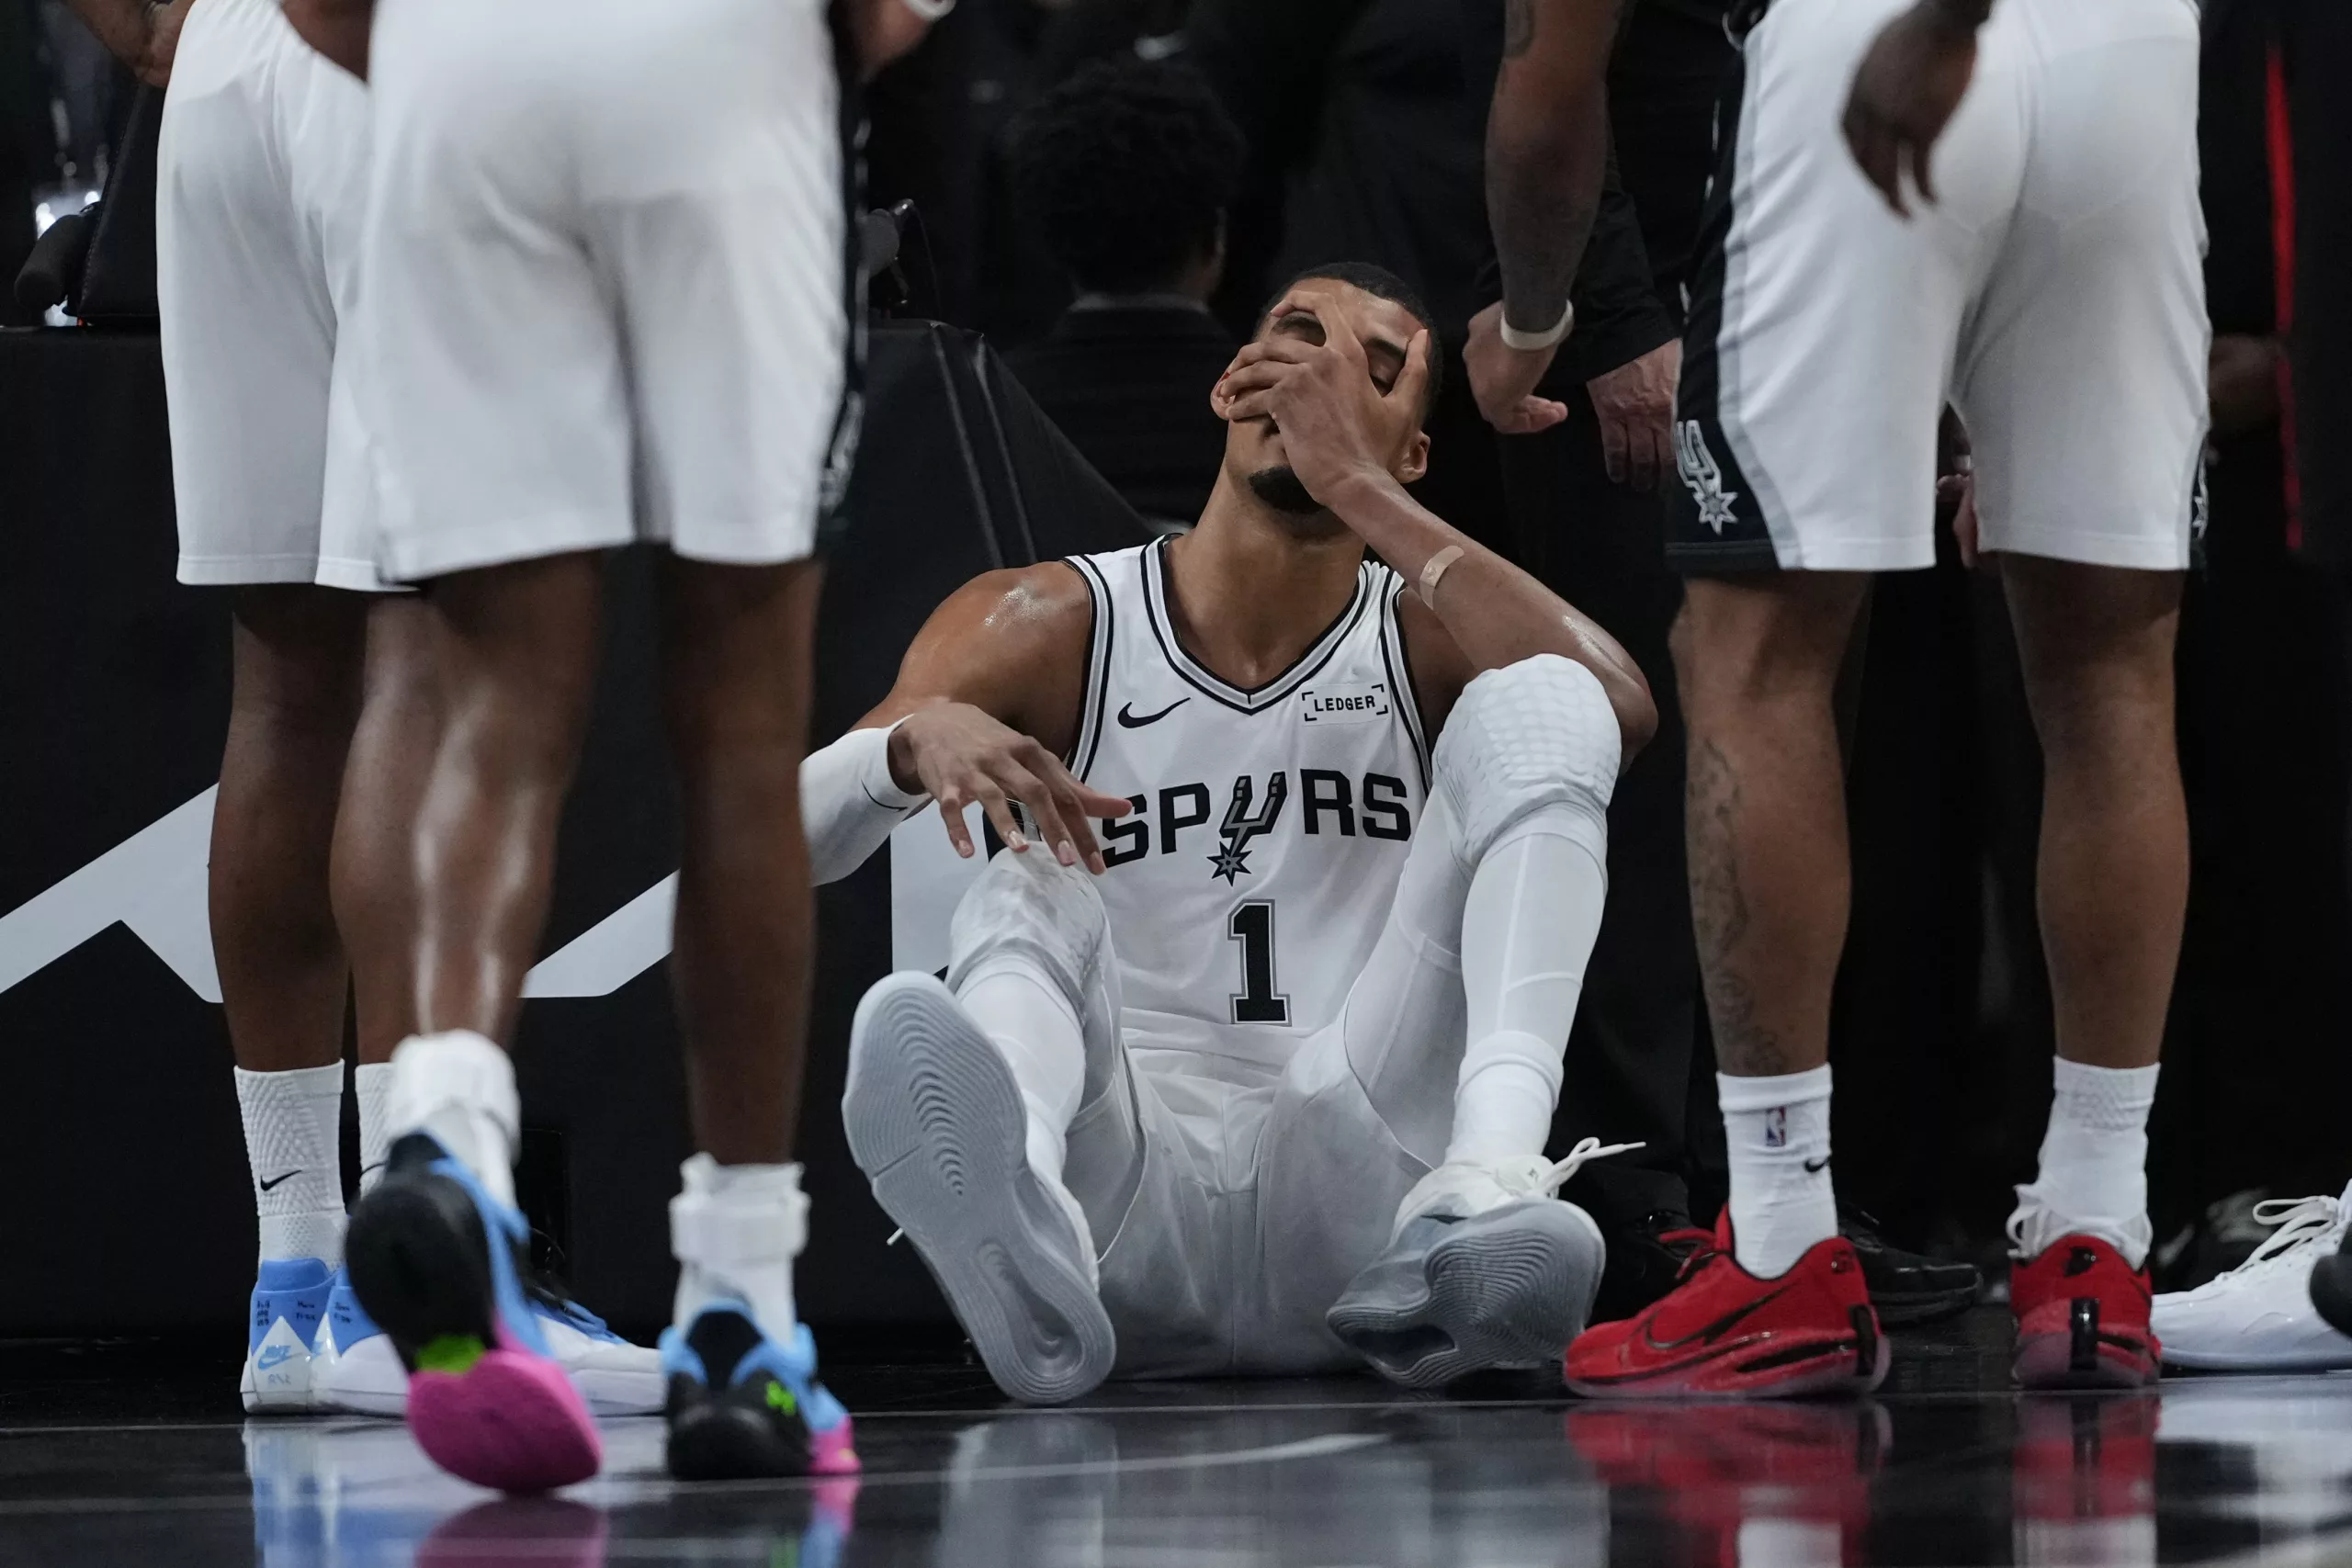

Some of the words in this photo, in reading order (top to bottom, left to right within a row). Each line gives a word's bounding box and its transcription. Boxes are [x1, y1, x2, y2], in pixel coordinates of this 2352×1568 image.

[1314, 695, 1375, 712] LEDGER
[1102, 769, 1411, 886] SPURS
[1227, 899, 1292, 1026] 1
